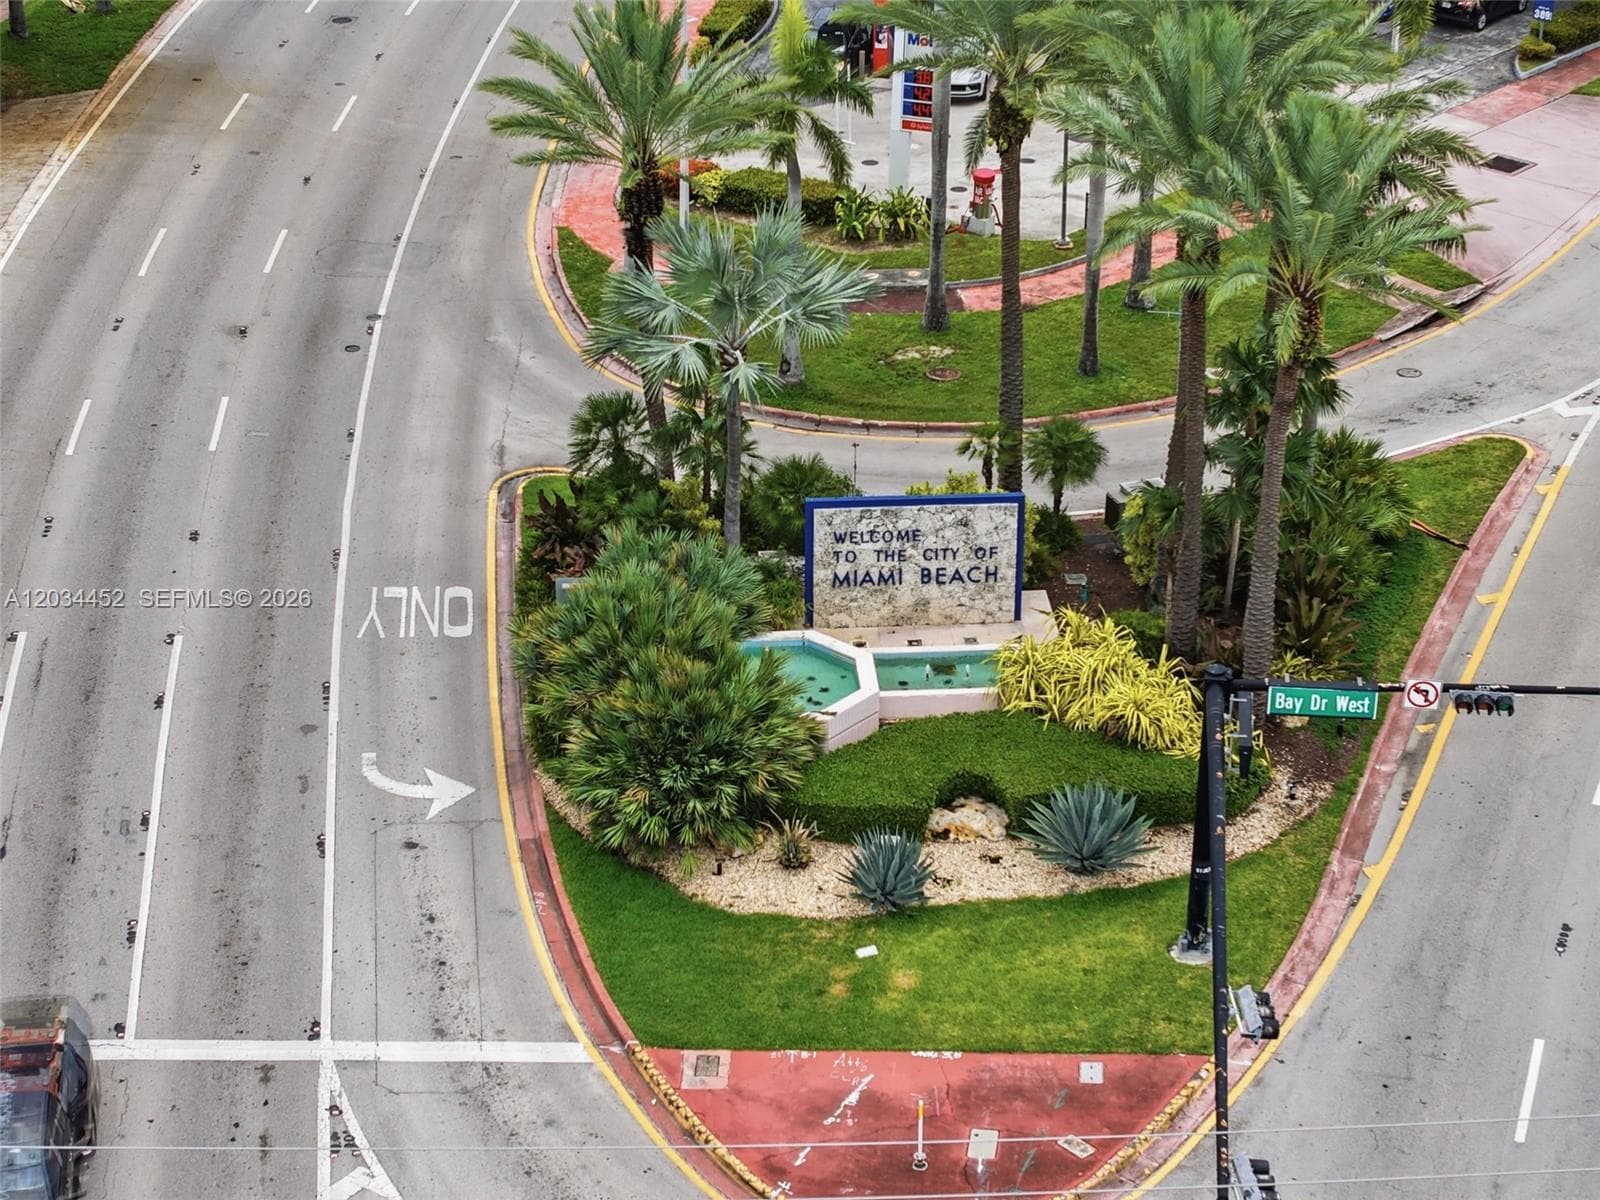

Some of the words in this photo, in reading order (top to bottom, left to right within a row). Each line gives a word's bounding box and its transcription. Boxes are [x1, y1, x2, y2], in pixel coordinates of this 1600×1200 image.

[833, 529, 922, 545] WELCOME
[833, 550, 857, 564] TO
[874, 549, 907, 563] THE
[922, 547, 960, 562] CITY
[974, 546, 999, 560] OF
[832, 568, 903, 588] MIAMI
[920, 565, 998, 585] BEACH
[356, 585, 474, 639] ONLY
[1275, 692, 1304, 714] Bay
[1310, 694, 1328, 711] Dr
[1336, 695, 1370, 713] West
